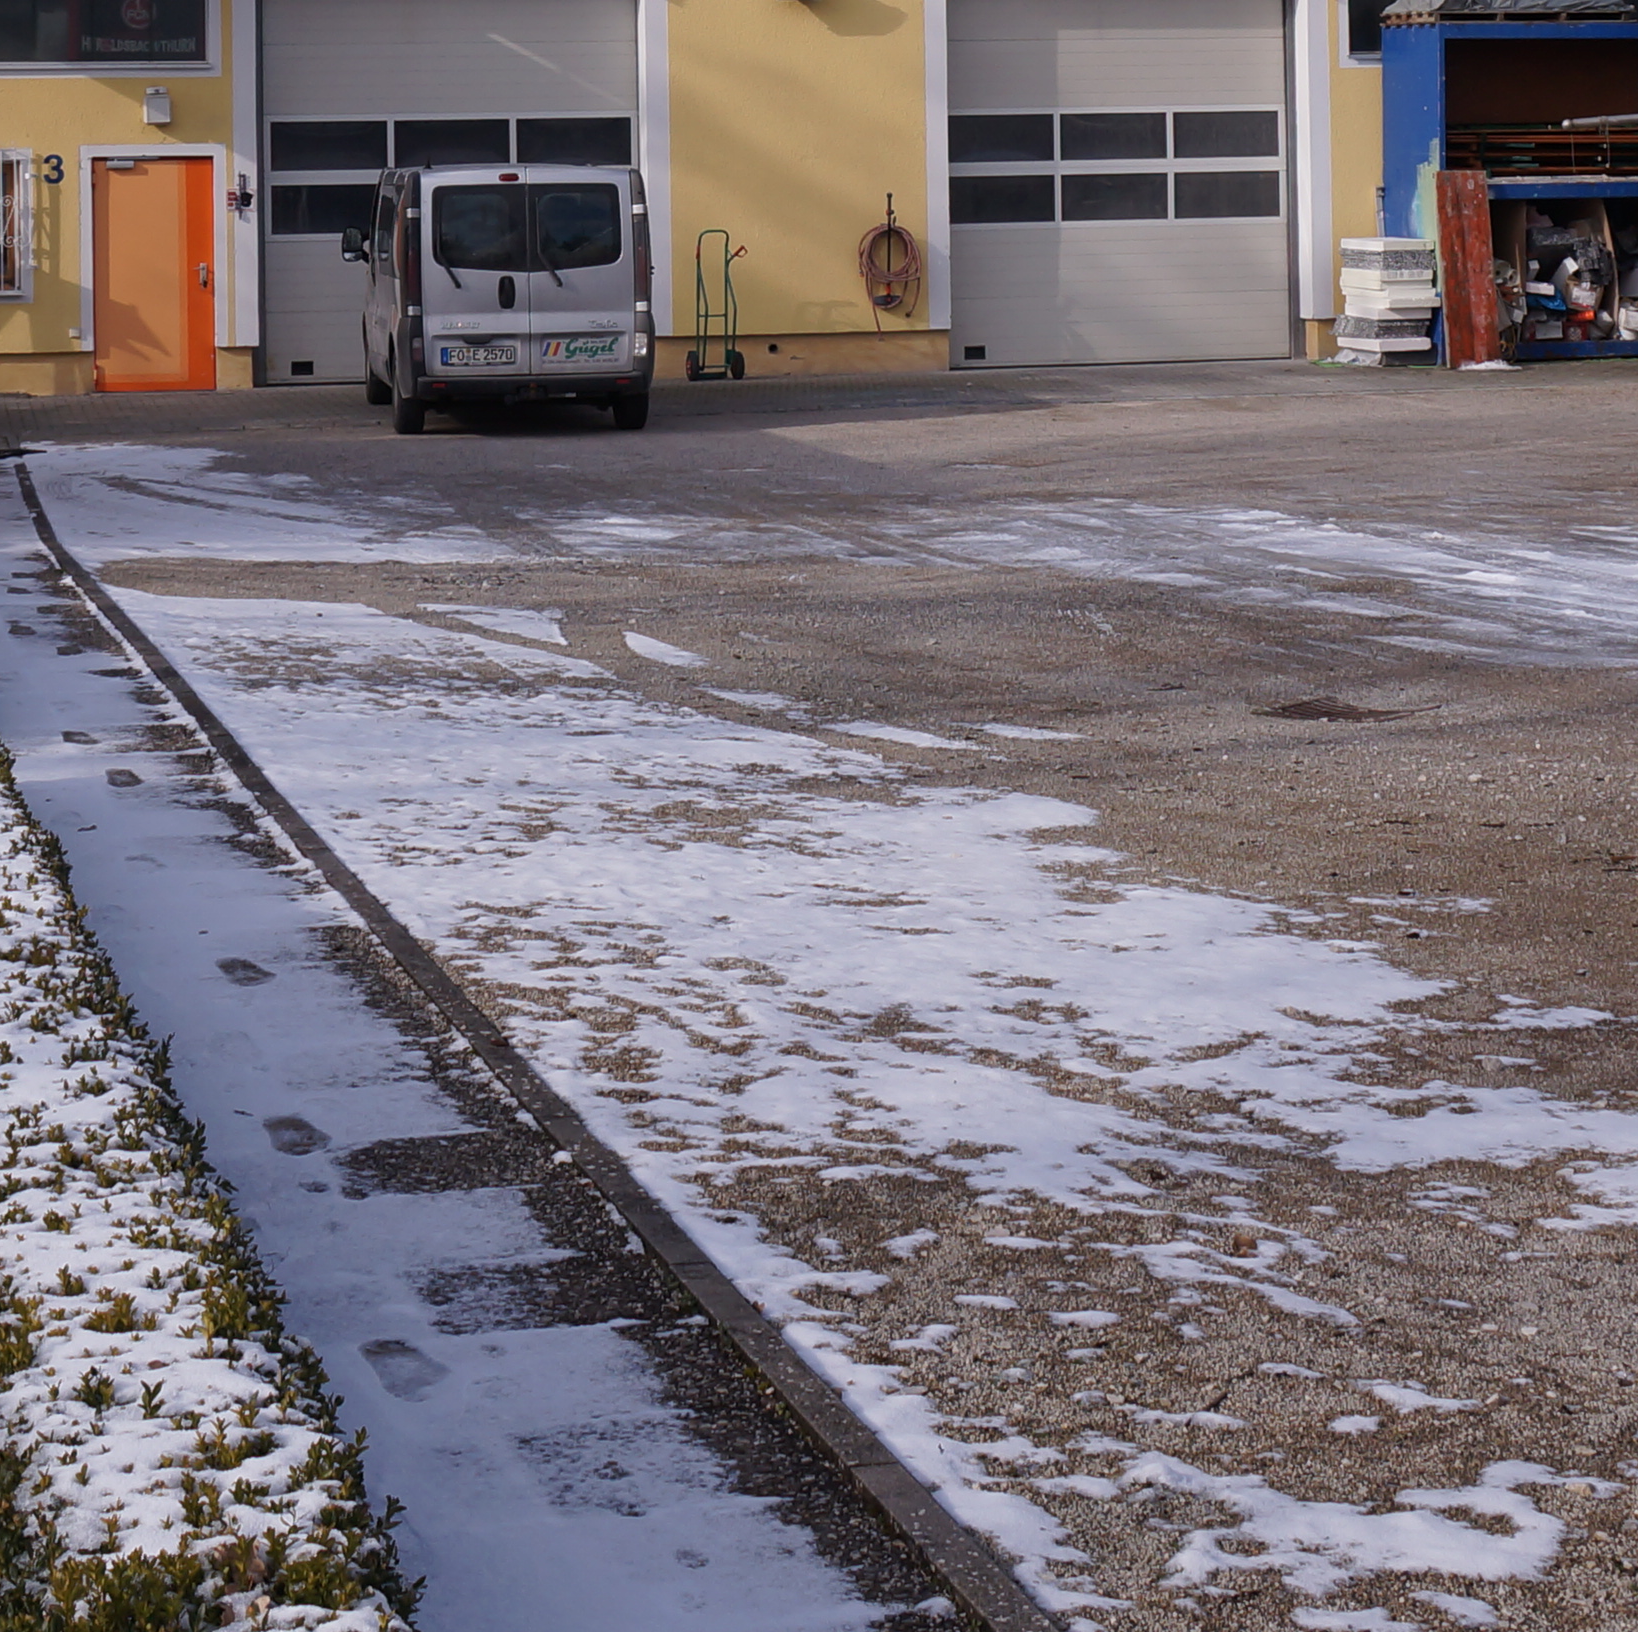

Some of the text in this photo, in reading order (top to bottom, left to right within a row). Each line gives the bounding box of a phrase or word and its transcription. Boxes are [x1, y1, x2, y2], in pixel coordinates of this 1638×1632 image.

[43, 154, 65, 185] 3
[449, 348, 513, 362] FO E 2570
